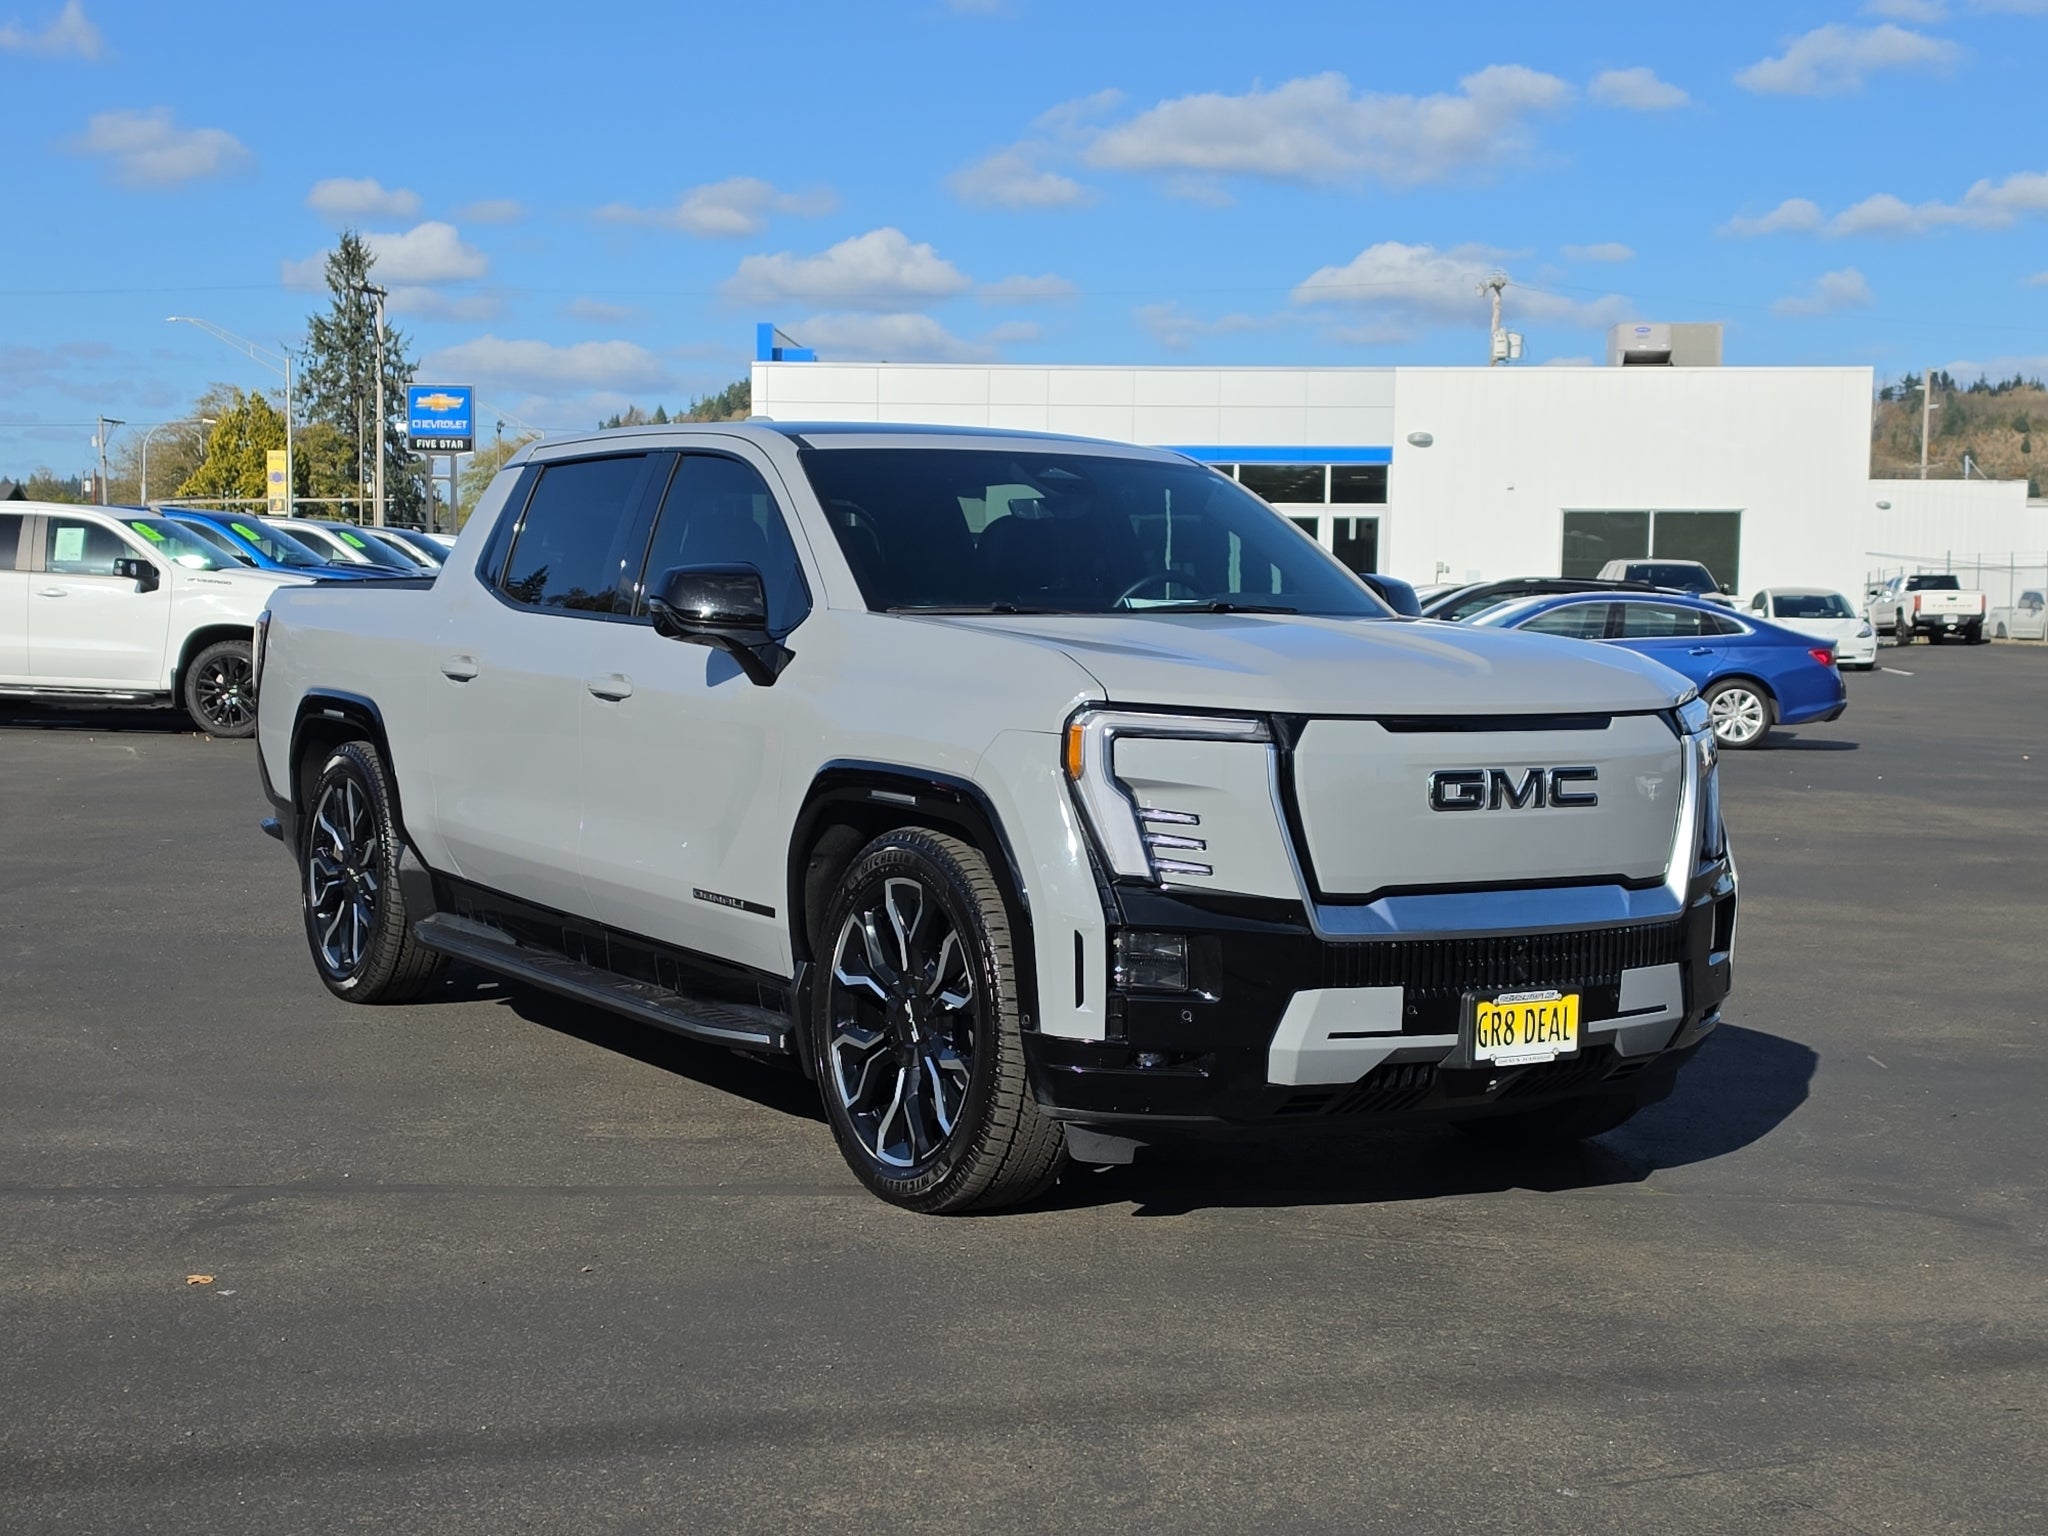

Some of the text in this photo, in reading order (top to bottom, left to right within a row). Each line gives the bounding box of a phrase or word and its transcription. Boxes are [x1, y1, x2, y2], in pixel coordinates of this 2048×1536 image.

[412, 419, 467, 429] CHEVROLET
[416, 439, 464, 449] FIVE STAR
[1428, 766, 1598, 812] GMC
[862, 851, 913, 876] MICHELIN
[1478, 1006, 1571, 1048] GR8 DEAL
